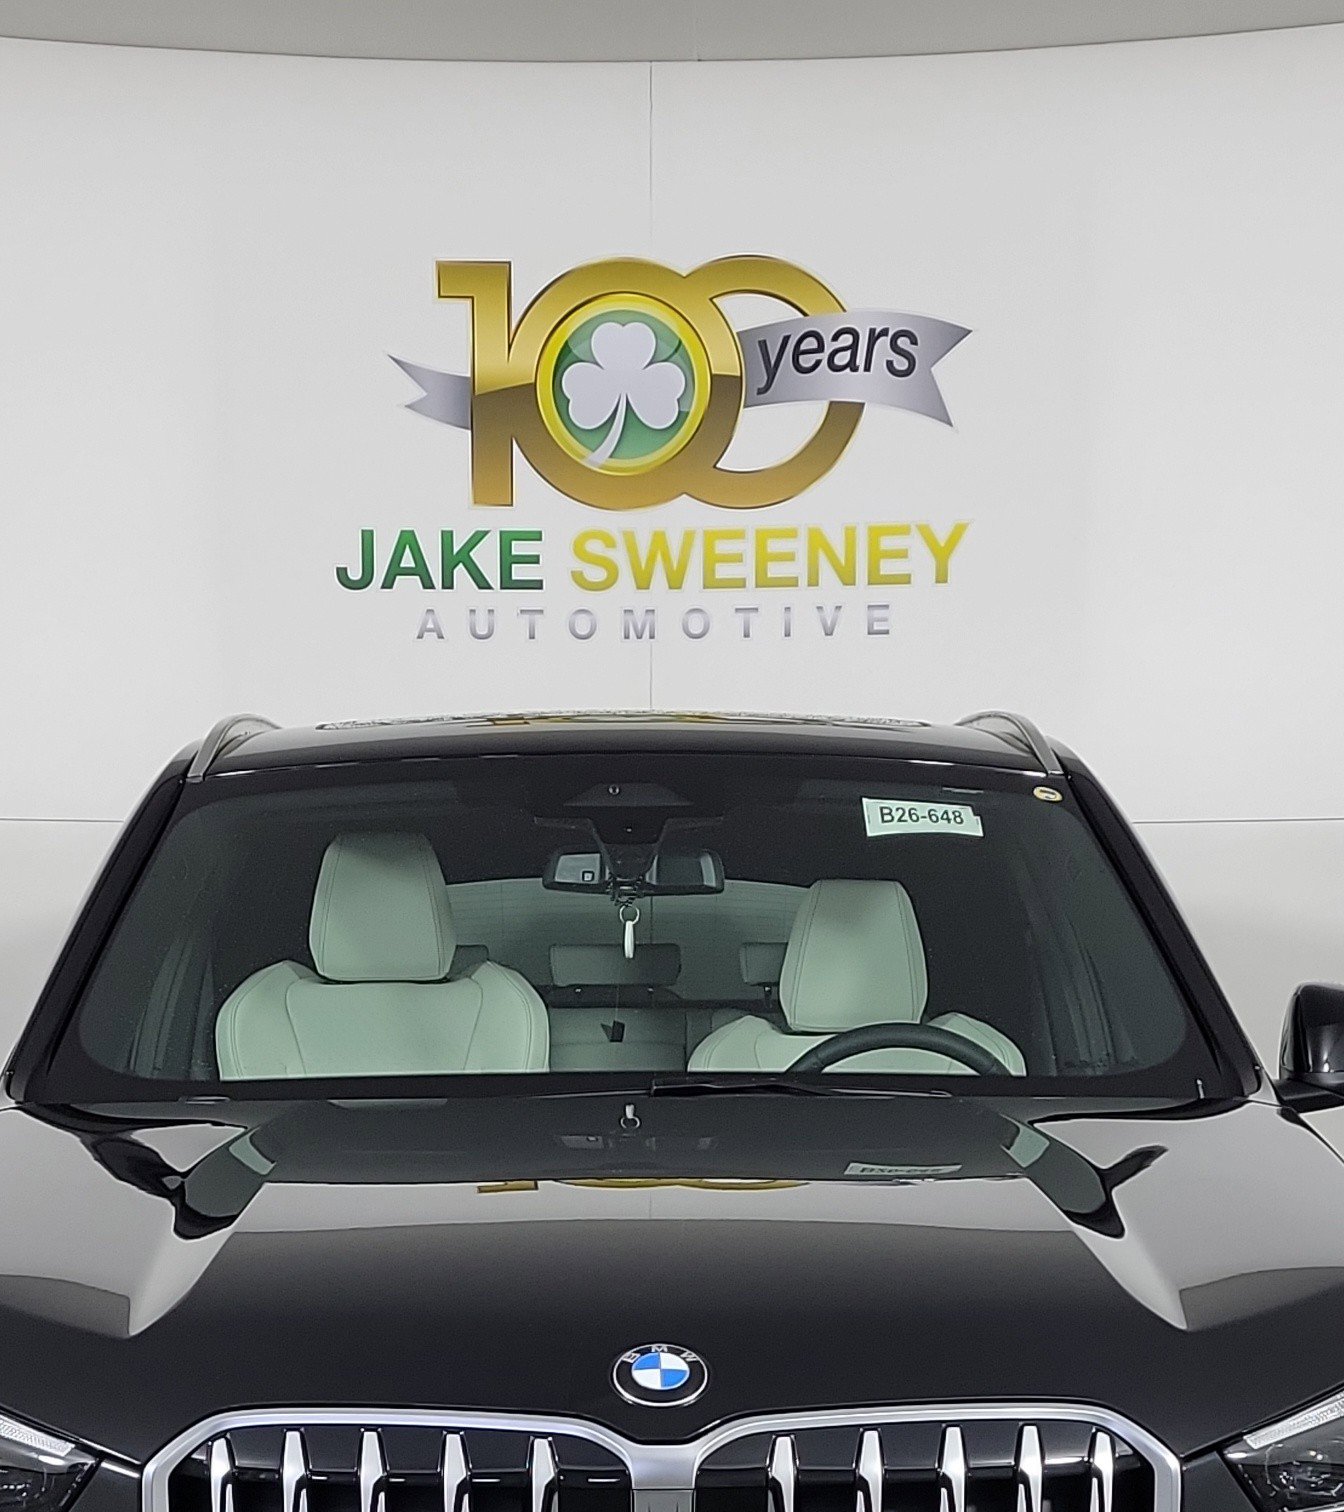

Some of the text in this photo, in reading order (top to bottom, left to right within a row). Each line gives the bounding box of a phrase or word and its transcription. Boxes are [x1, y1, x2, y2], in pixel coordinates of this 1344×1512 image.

[434, 255, 920, 511] 100 years
[334, 522, 970, 592] JAKE SWEENEY
[416, 603, 892, 641] AUTOMOTIVE
[879, 806, 965, 826] B26-648
